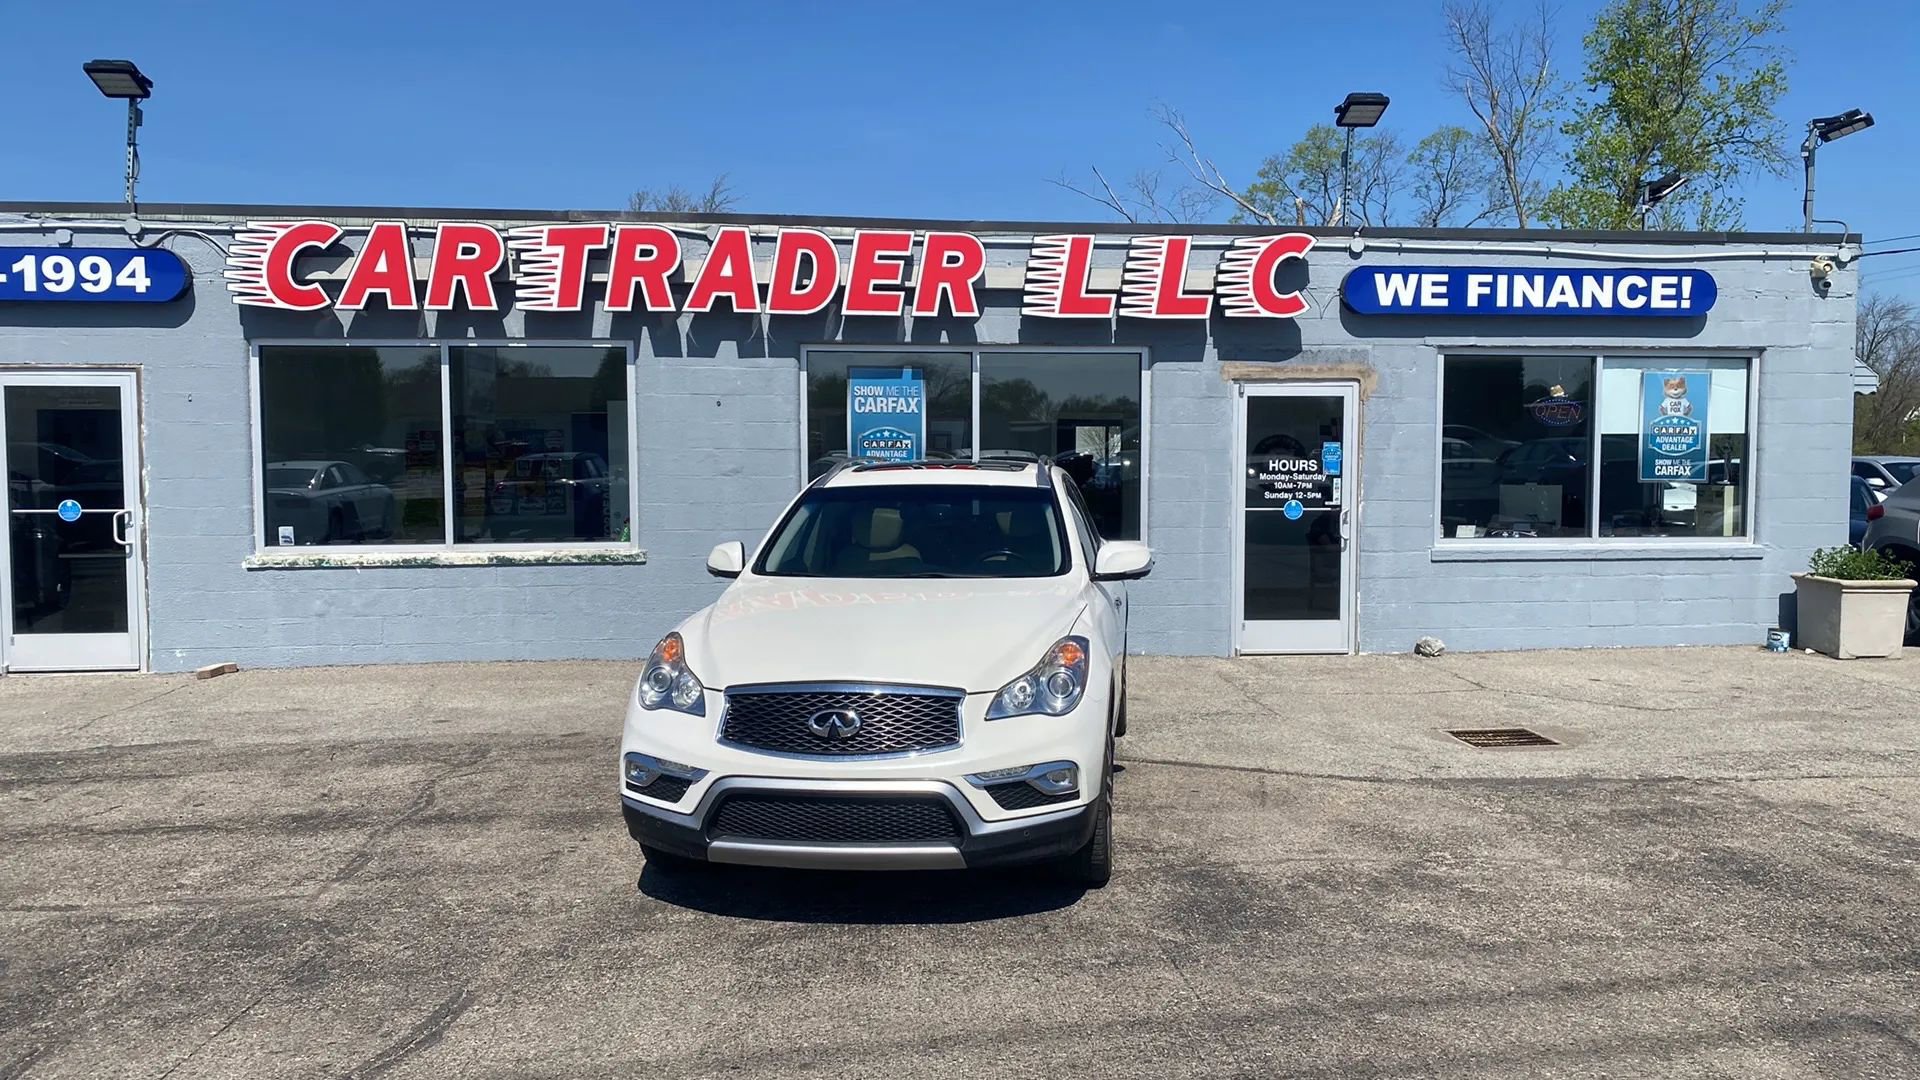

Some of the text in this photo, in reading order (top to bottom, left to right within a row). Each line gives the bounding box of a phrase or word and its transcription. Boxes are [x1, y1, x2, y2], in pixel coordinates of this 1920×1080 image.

[224, 220, 1318, 319] CAR TRADER LLC
[1374, 273, 1693, 309] WE FINANCE!
[854, 385, 919, 396] SHOW ME THE
[854, 397, 919, 413] CARFAX
[1653, 426, 1697, 435] CARFAX
[863, 440, 911, 448] CARFAX
[1662, 443, 1687, 451] DEALER
[866, 450, 908, 458] ADVANTAGE
[1269, 460, 1318, 471] HOURS
[1655, 466, 1691, 476] CARFAX
[1260, 473, 1327, 481] Monday-Saturday
[1264, 492, 1293, 500] Sunday
